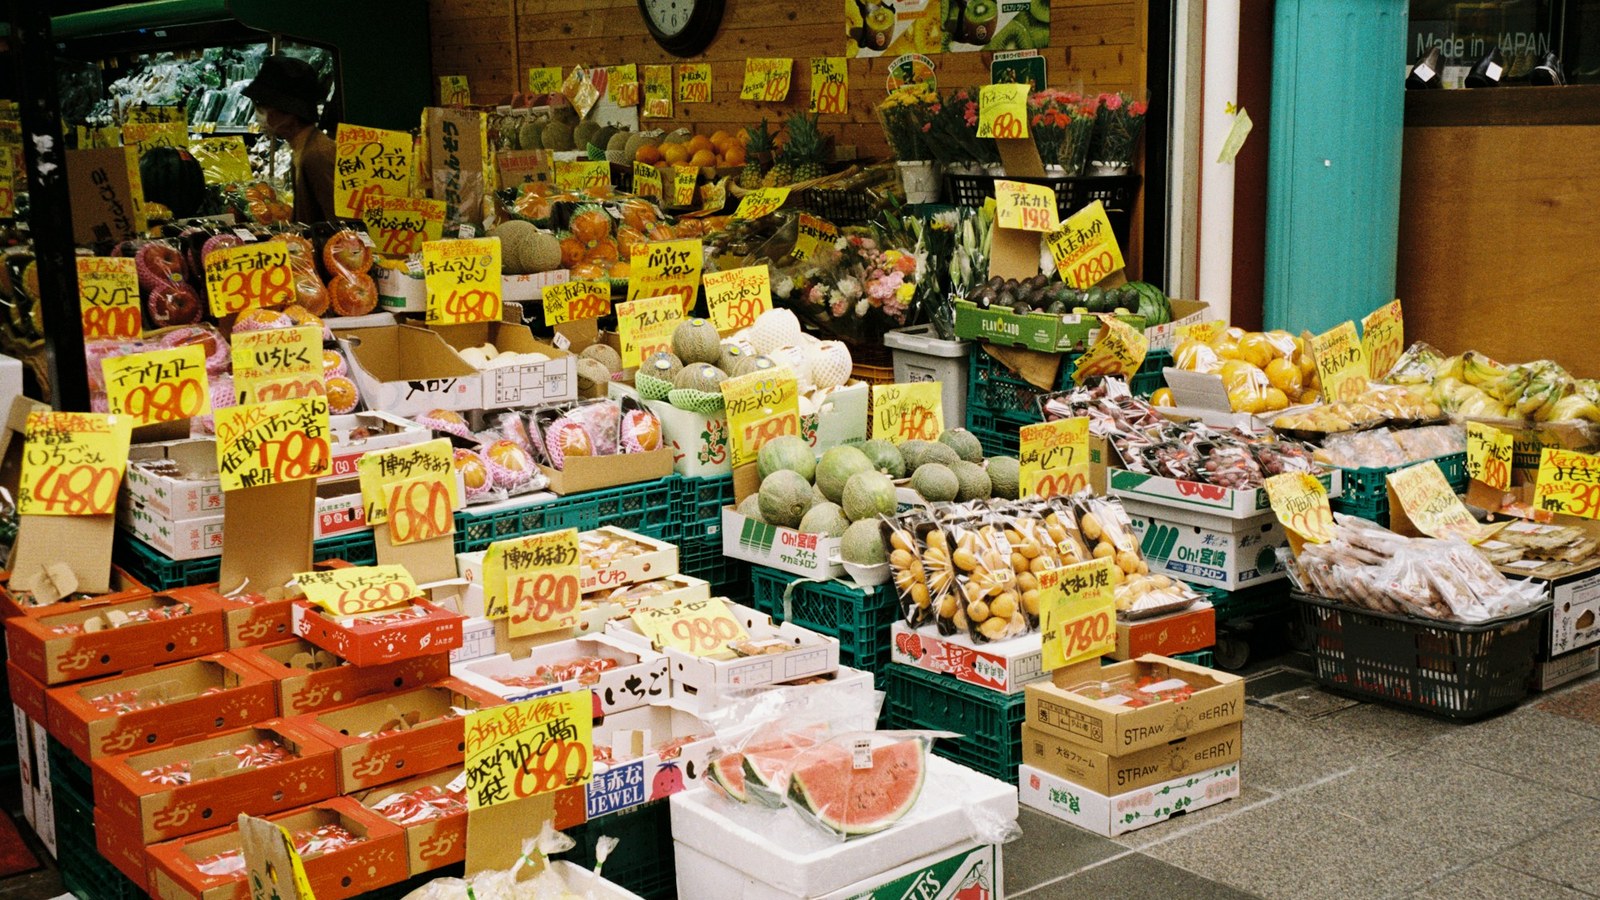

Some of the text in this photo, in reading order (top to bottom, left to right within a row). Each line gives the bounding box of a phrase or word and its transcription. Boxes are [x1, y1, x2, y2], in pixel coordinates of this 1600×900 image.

[671, 14, 677, 27] 6
[1416, 31, 1551, 58] Made in JAPAN
[817, 80, 848, 113] 680
[993, 112, 1022, 138] 680
[370, 167, 406, 181] メロン
[1010, 193, 1052, 207] アボカド
[1022, 207, 1051, 230] 198
[380, 229, 428, 257] 780
[1055, 218, 1103, 262] 小玉すいか
[232, 251, 286, 272] デコポン
[426, 256, 476, 276] ホームラン
[648, 247, 691, 268] パパイヤ
[660, 265, 695, 276] メロン
[1072, 251, 1114, 289] 1980
[221, 265, 296, 313] 398
[456, 269, 487, 284] メロン
[83, 285, 141, 306] マンゴー
[444, 289, 499, 323] 480
[568, 294, 610, 321] 1280
[707, 284, 762, 309] ホームランメロン
[727, 298, 765, 328] 580
[256, 347, 310, 367] いちじく
[124, 378, 204, 424] 980
[405, 378, 458, 401] メロン
[726, 388, 784, 417] タカミメロン
[27, 445, 106, 467] いちごさん
[378, 449, 451, 478] 博多あまおう
[1041, 446, 1074, 471] ビワ
[33, 465, 121, 516] 480
[208, 494, 221, 508] 秀
[388, 480, 453, 543] 680
[210, 533, 223, 546] 秀
[781, 532, 818, 551] Oh!宮崎
[502, 543, 578, 570] 博多あまおう
[780, 554, 818, 569] タカミメロン
[796, 549, 818, 560] スイート
[1177, 545, 1227, 568] Oh!宮崎
[597, 569, 627, 585] びわ
[1184, 564, 1226, 582] 温室メロン
[338, 581, 411, 616] 680
[511, 573, 579, 624] 580
[373, 631, 409, 648] いちごさん
[671, 616, 740, 653] 980
[1065, 612, 1110, 658] 780
[605, 665, 668, 706] いちご
[1124, 699, 1238, 746] STRAW BERRY
[513, 737, 588, 799] 680
[1055, 745, 1096, 769] 大谷ファーム
[1117, 738, 1235, 786] STRAW BERRY
[589, 765, 642, 796] 真赤な
[588, 786, 643, 817] JEWEL
